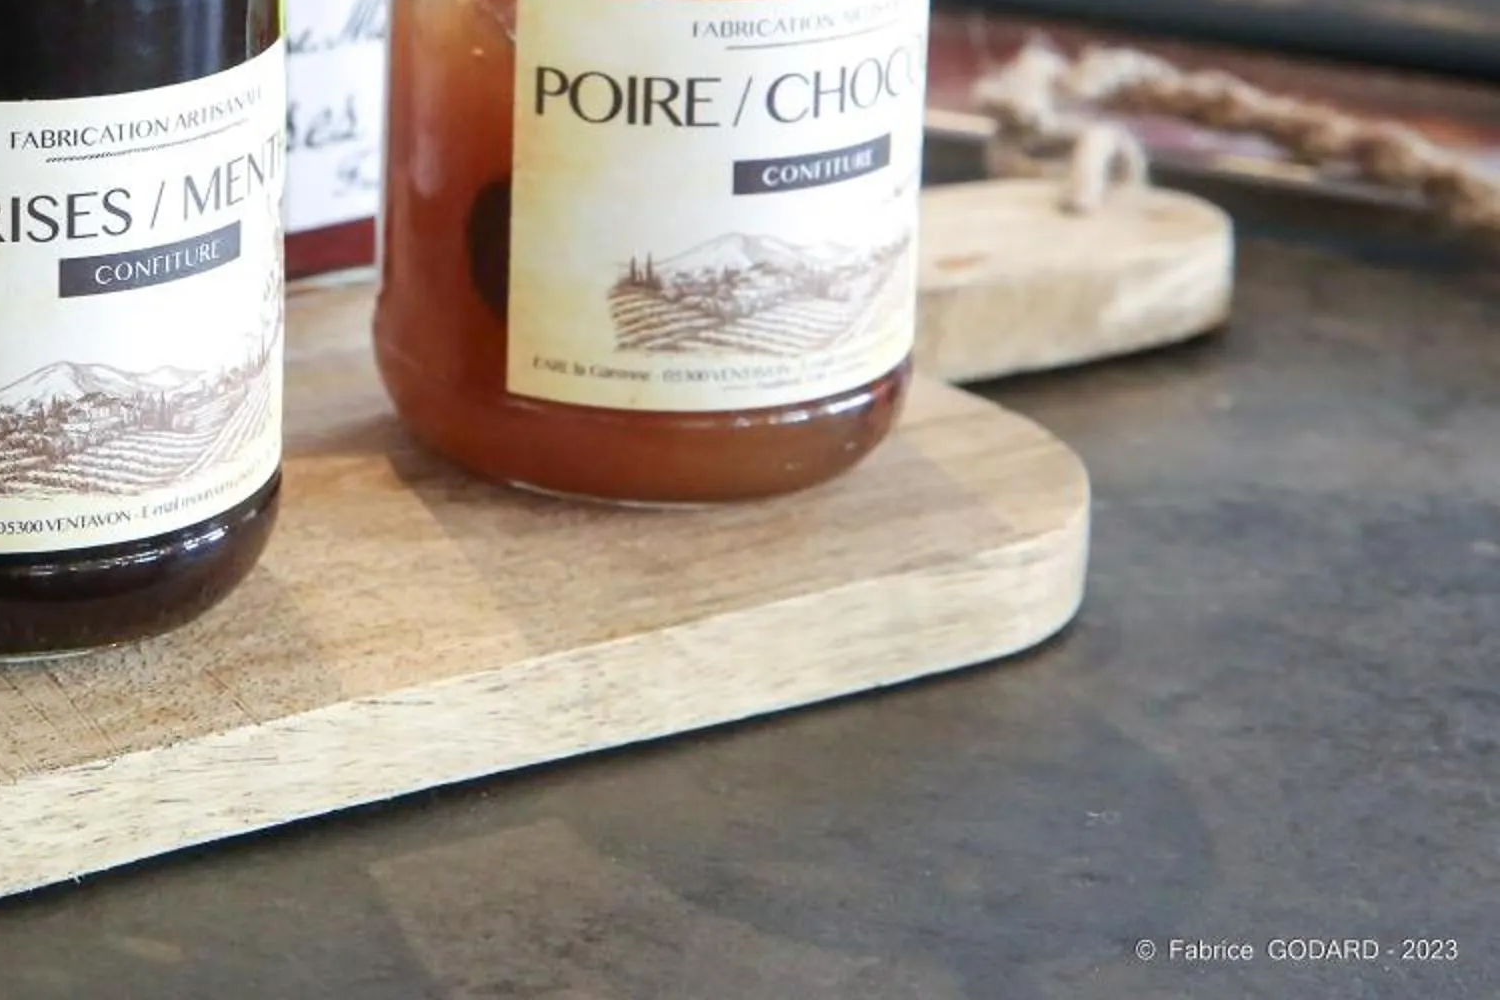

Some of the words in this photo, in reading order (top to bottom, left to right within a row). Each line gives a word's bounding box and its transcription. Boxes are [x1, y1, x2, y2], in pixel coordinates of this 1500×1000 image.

[692, 15, 834, 38] FABRICATION
[535, 66, 722, 127] POIRE
[732, 76, 753, 127] /
[10, 116, 169, 150] FABRICATION
[762, 149, 873, 187] CONFITURE
[149, 180, 166, 229] /
[95, 240, 221, 285] CONFITURE
[45, 510, 131, 532] VENTAVON
